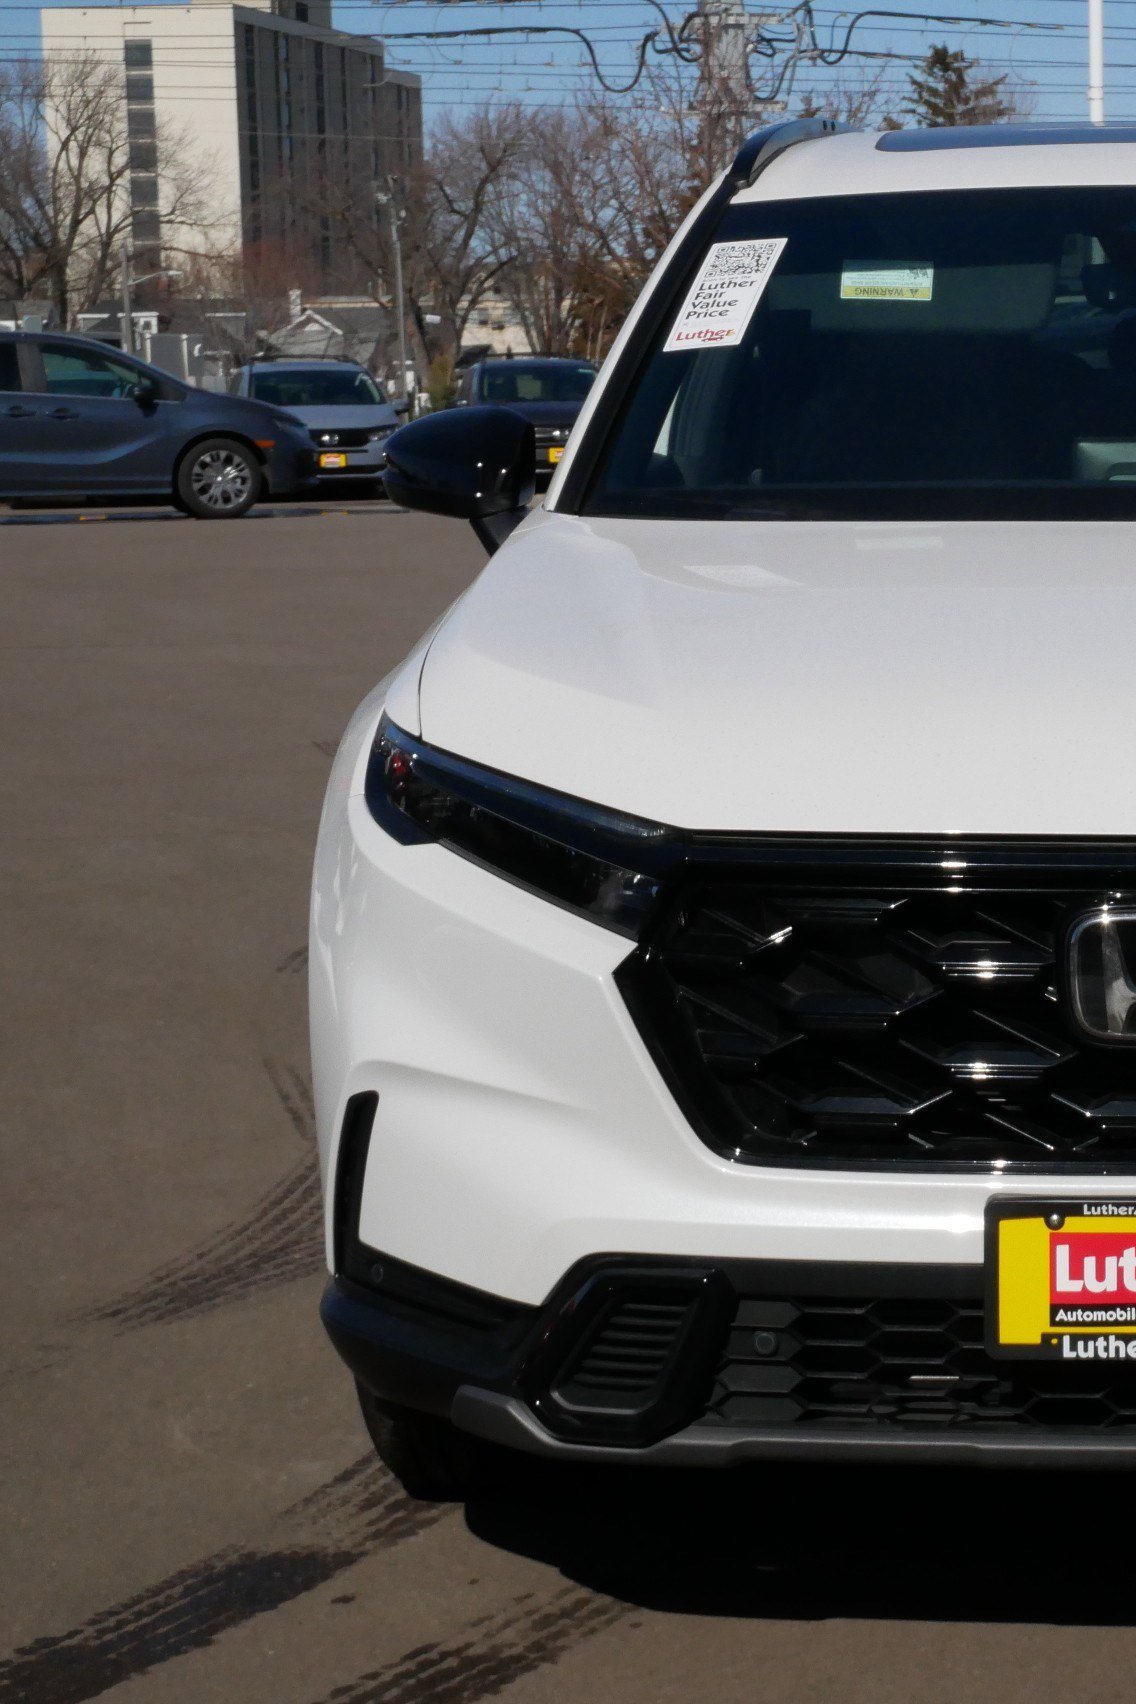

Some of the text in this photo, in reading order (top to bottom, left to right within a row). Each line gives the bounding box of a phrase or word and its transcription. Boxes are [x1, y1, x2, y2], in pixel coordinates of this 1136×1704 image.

[698, 280, 757, 291] Luther
[694, 290, 726, 301] Fair
[854, 287, 904, 296] WARNING
[691, 299, 739, 309] Value
[685, 309, 730, 320] Price
[676, 329, 735, 341] Luther
